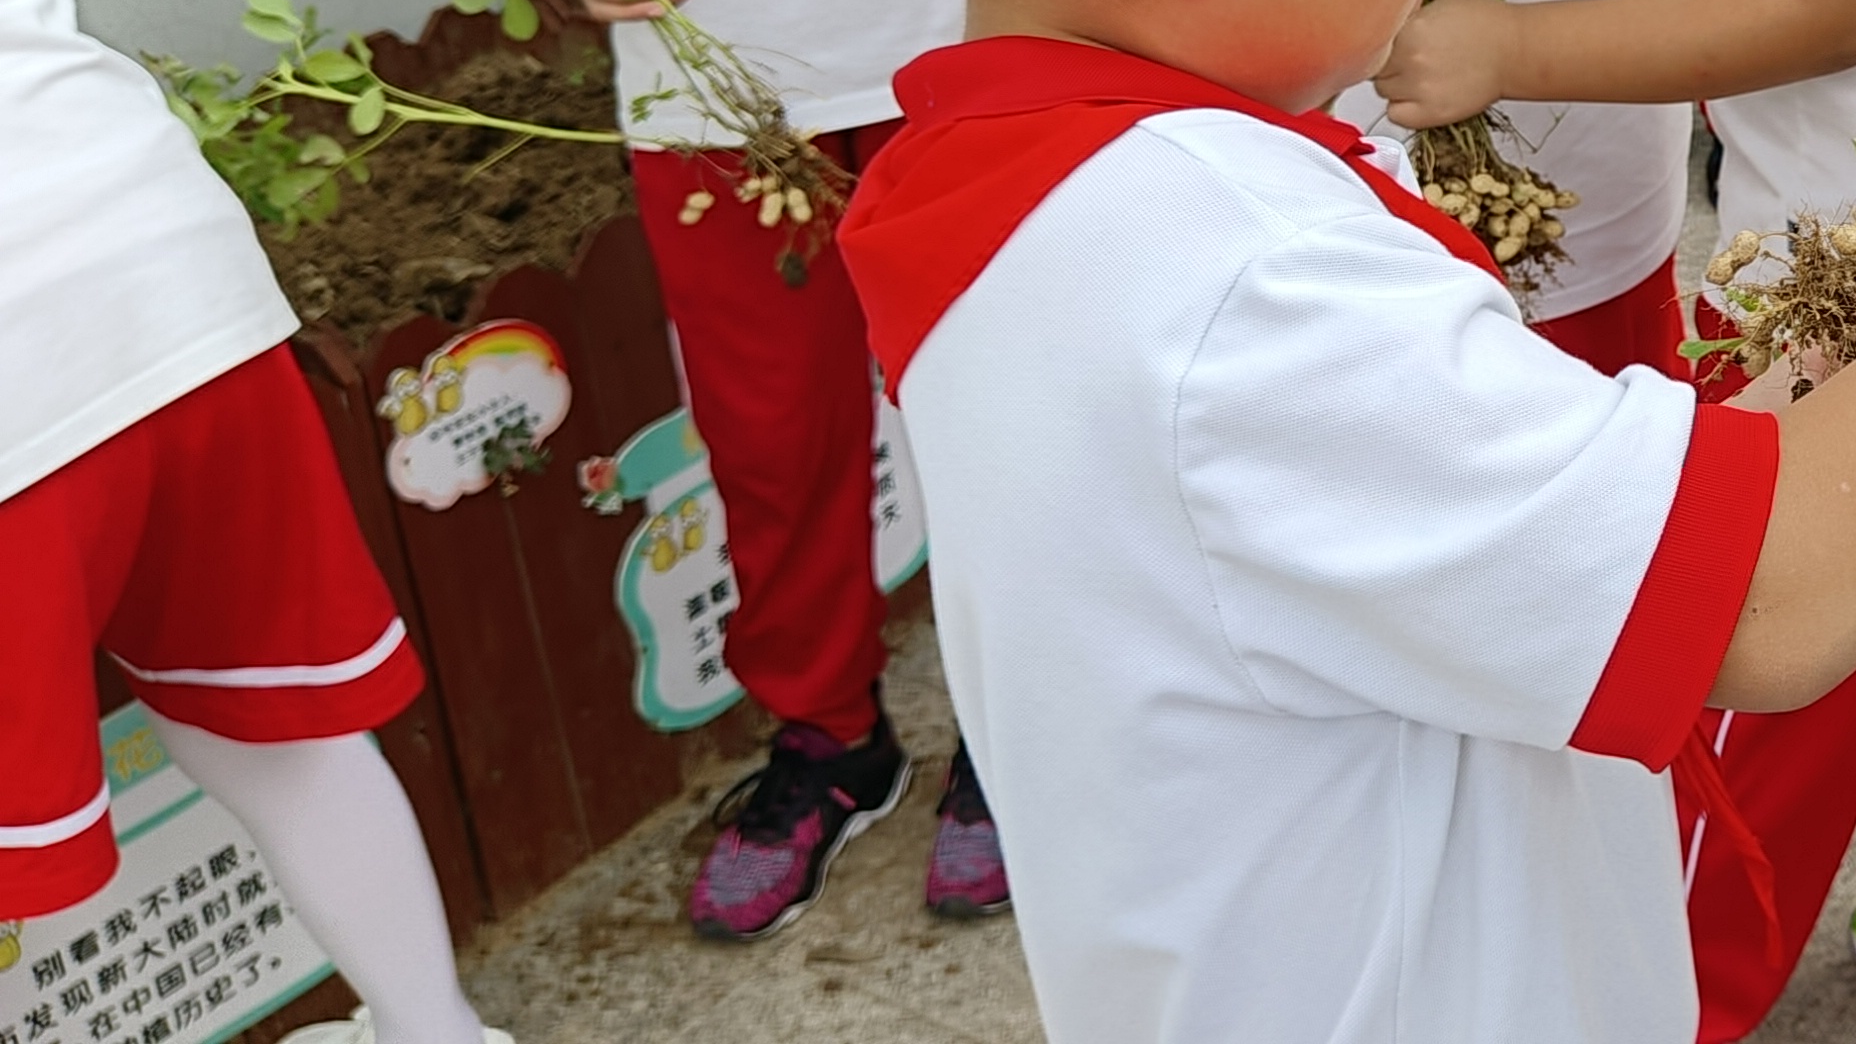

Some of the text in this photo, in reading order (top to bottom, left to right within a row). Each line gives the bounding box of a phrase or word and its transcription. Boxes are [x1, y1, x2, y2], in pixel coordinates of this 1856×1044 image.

[107, 728, 164, 782] 花
[0, 871, 278, 1044] 发现新大陆时就
[88, 901, 296, 1042] 在中国已经有
[122, 954, 282, 1044] 植历史了。
